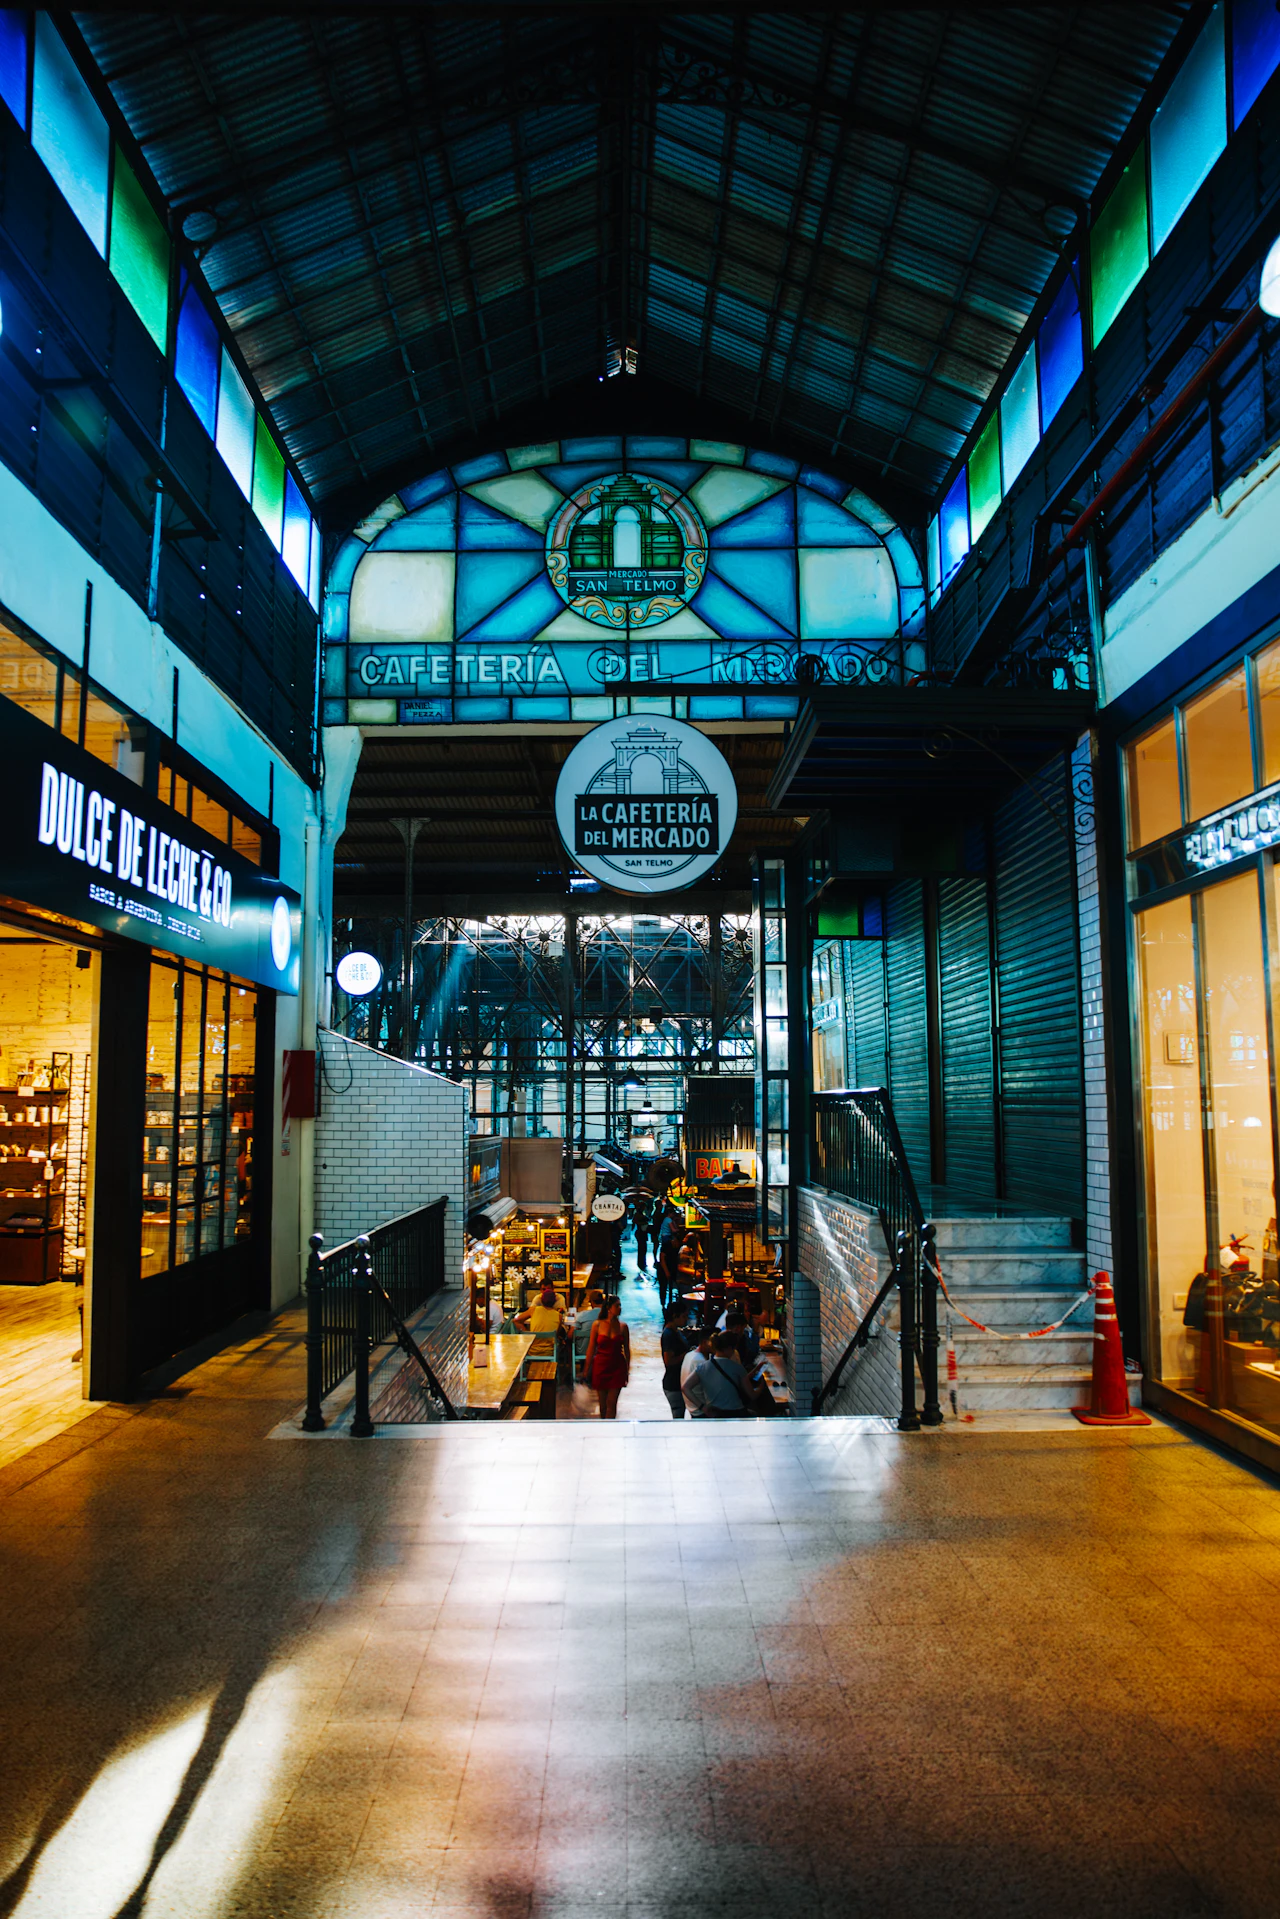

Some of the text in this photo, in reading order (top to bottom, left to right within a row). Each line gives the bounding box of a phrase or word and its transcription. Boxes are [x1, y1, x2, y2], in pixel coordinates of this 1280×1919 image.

[608, 570, 647, 578] MERCADO
[576, 580, 677, 592] SAN TELMO
[360, 645, 564, 685] CAFETERÍA
[604, 653, 673, 683] DEL
[581, 796, 713, 824] LA CAFETERÍA
[38, 762, 116, 874] DULCE
[118, 809, 146, 888] DE
[147, 826, 200, 913] LECHE
[200, 855, 213, 920] &
[584, 827, 710, 849] DEL MERCADO
[625, 859, 673, 867] SAN TELMO
[360, 964, 367, 972] DE
[593, 1203, 623, 1211] CHANTAL
